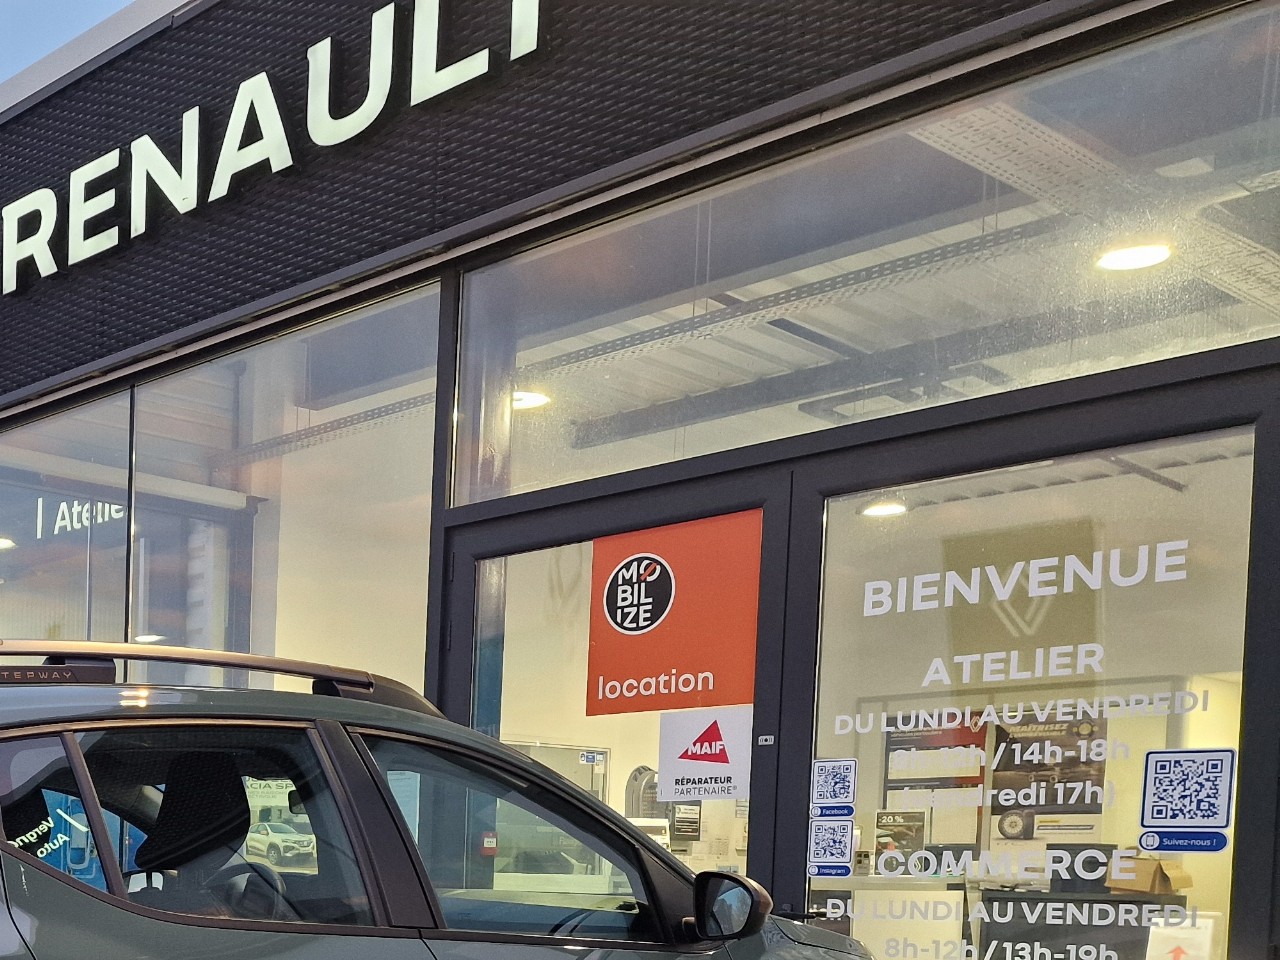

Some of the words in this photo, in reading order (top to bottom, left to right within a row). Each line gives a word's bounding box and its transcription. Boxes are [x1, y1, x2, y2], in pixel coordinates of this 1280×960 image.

[53, 500, 128, 535] Atelie
[863, 539, 1189, 617] BIENVENUE
[921, 642, 1105, 687] ATELIER
[598, 668, 714, 699] location
[835, 713, 873, 735] DU
[880, 706, 970, 732] LUNDI
[978, 702, 1024, 725] AU
[1031, 690, 1209, 724] VENDREDI
[687, 741, 725, 756] MAIF
[674, 775, 732, 786] RÉPARATEUR
[902, 779, 1046, 810] (dredi
[822, 807, 849, 815] Facebook
[1163, 837, 1211, 847] Suivez-nous
[819, 866, 846, 875] Instagram
[877, 849, 1138, 880] COMMERCE
[871, 900, 960, 921] LUNDI
[968, 901, 1014, 923] AU
[1020, 902, 1198, 928] VENDREDI
